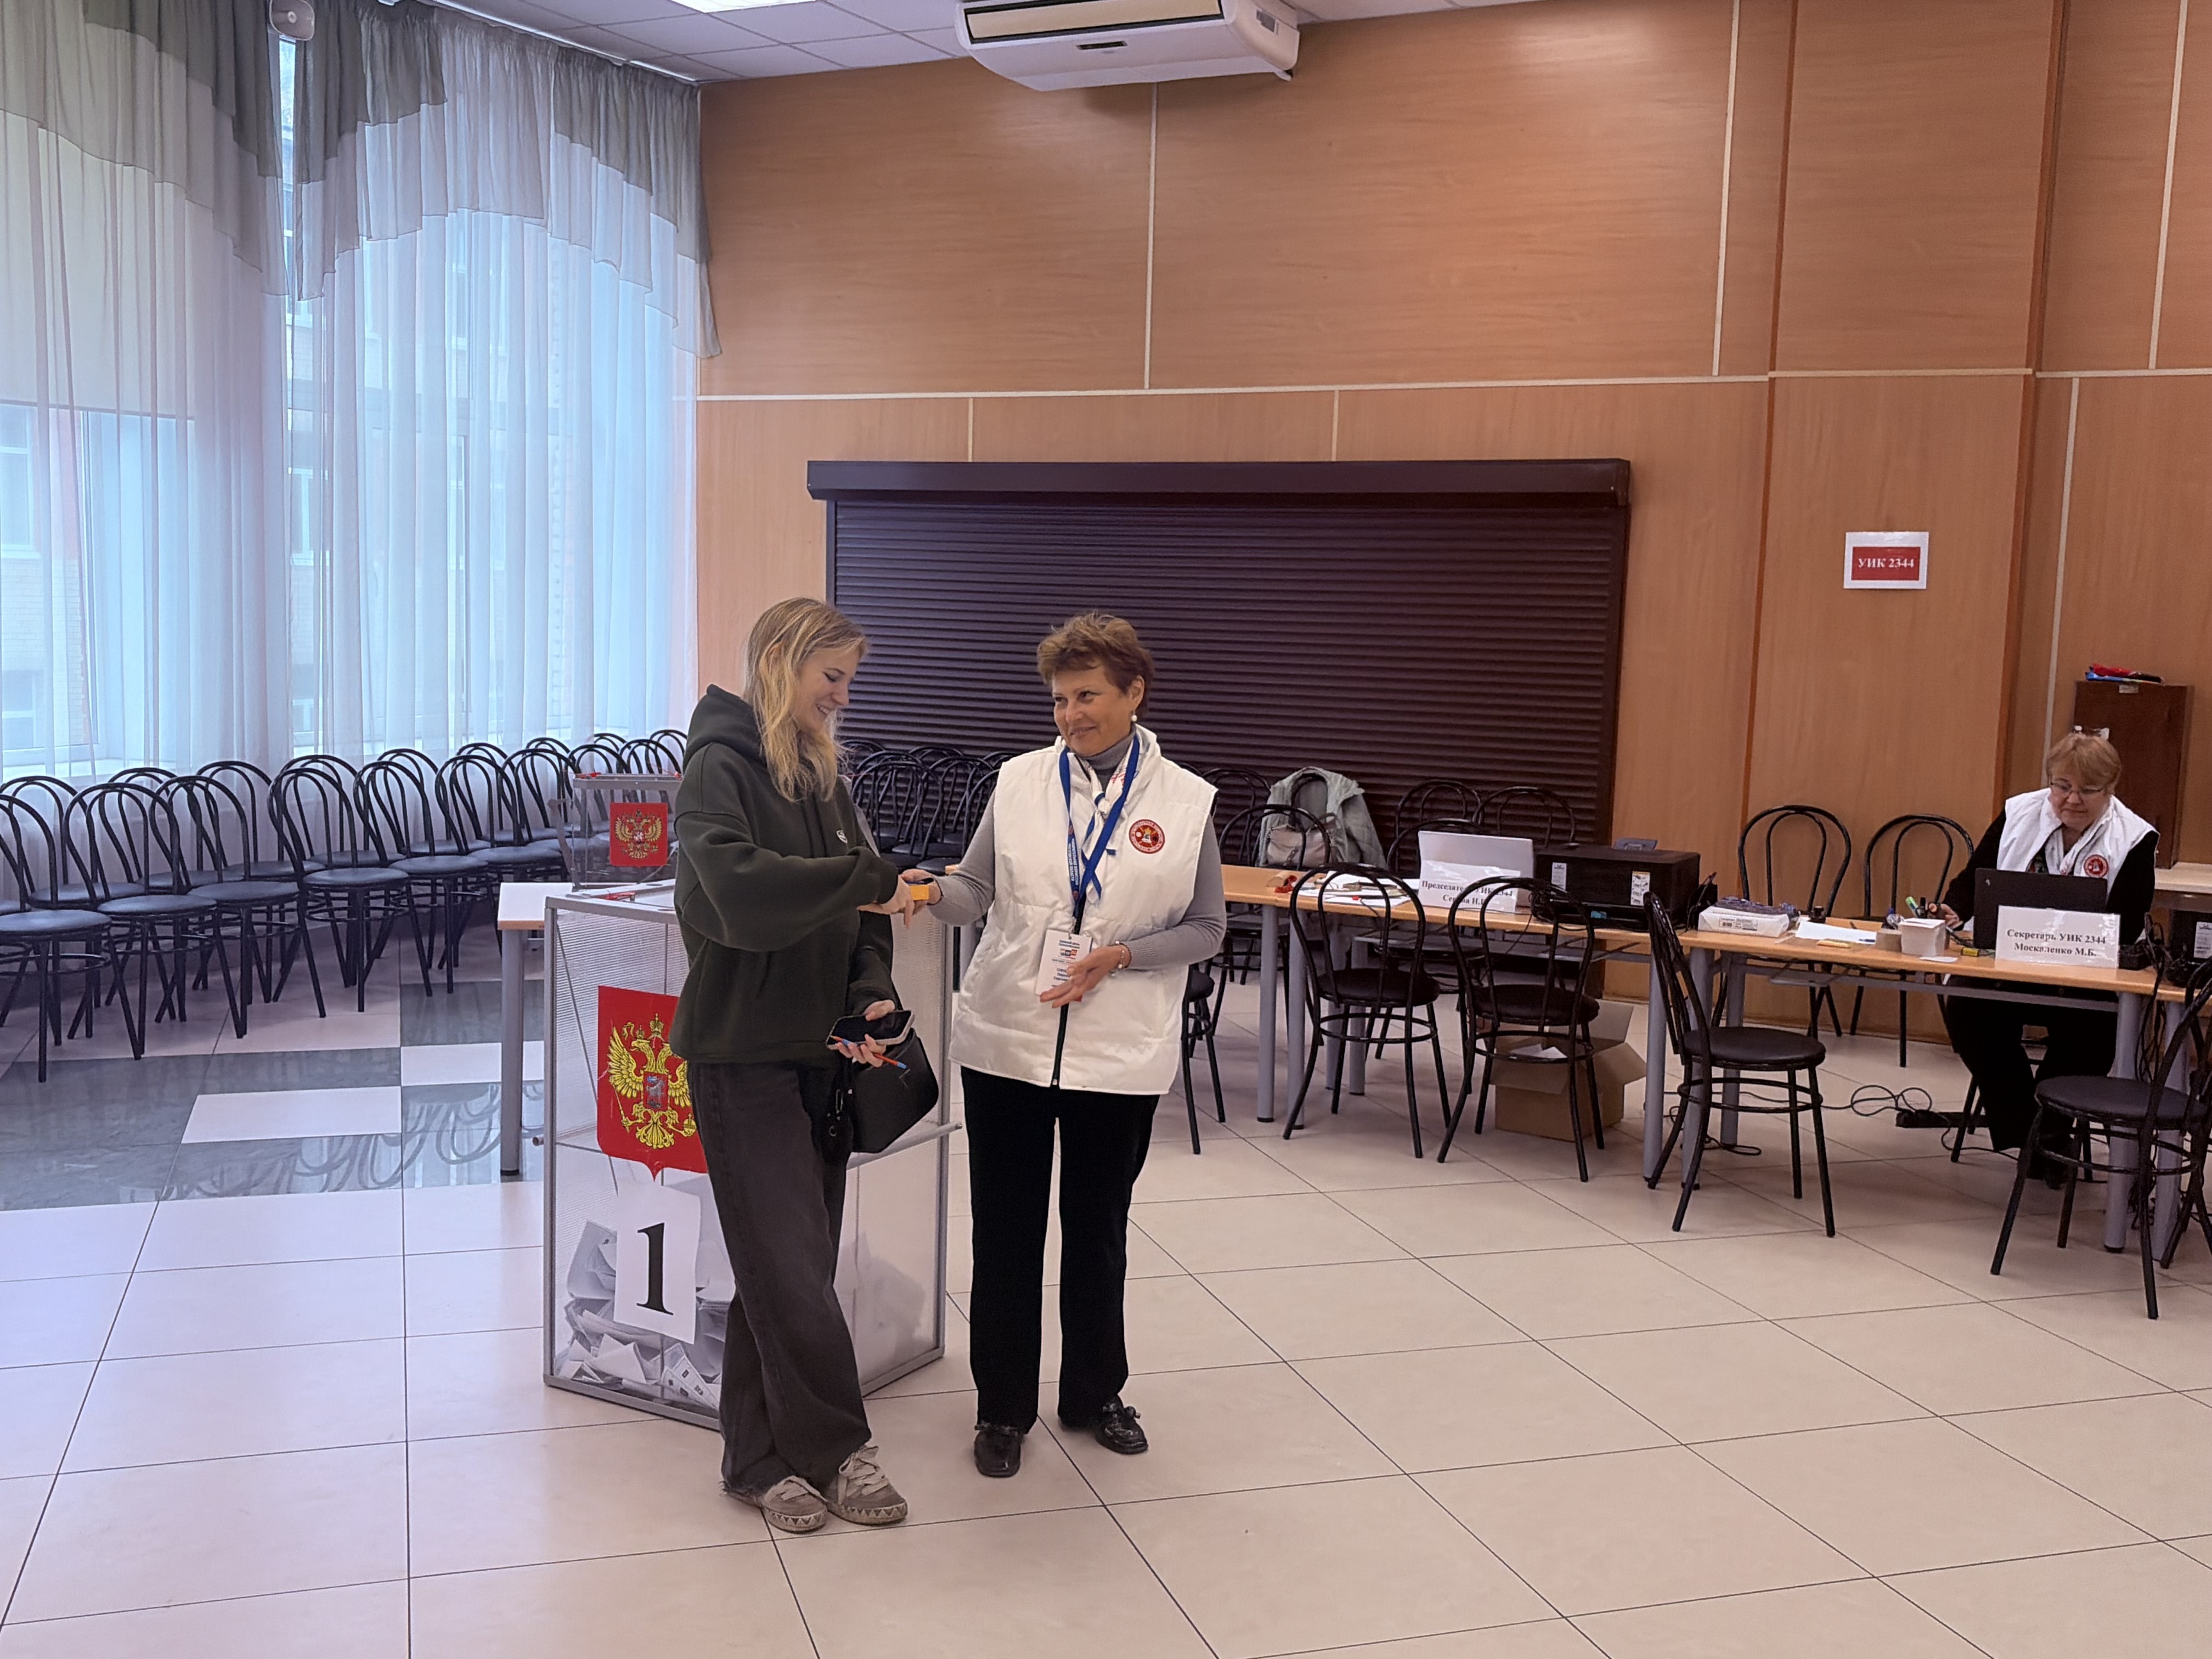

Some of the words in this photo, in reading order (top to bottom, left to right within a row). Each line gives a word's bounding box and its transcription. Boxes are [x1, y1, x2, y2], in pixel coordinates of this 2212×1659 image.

[1858, 557, 1886, 568] УИК
[1888, 557, 1914, 568] 2344
[1422, 881, 1465, 893] Председате
[2007, 929, 2056, 942] Секретарь
[2059, 933, 2083, 943] УИК
[2085, 935, 2106, 944] 2344
[2014, 943, 2072, 955] Москаленко
[2075, 947, 2097, 956] М.Б.
[636, 1222, 674, 1316] 1
